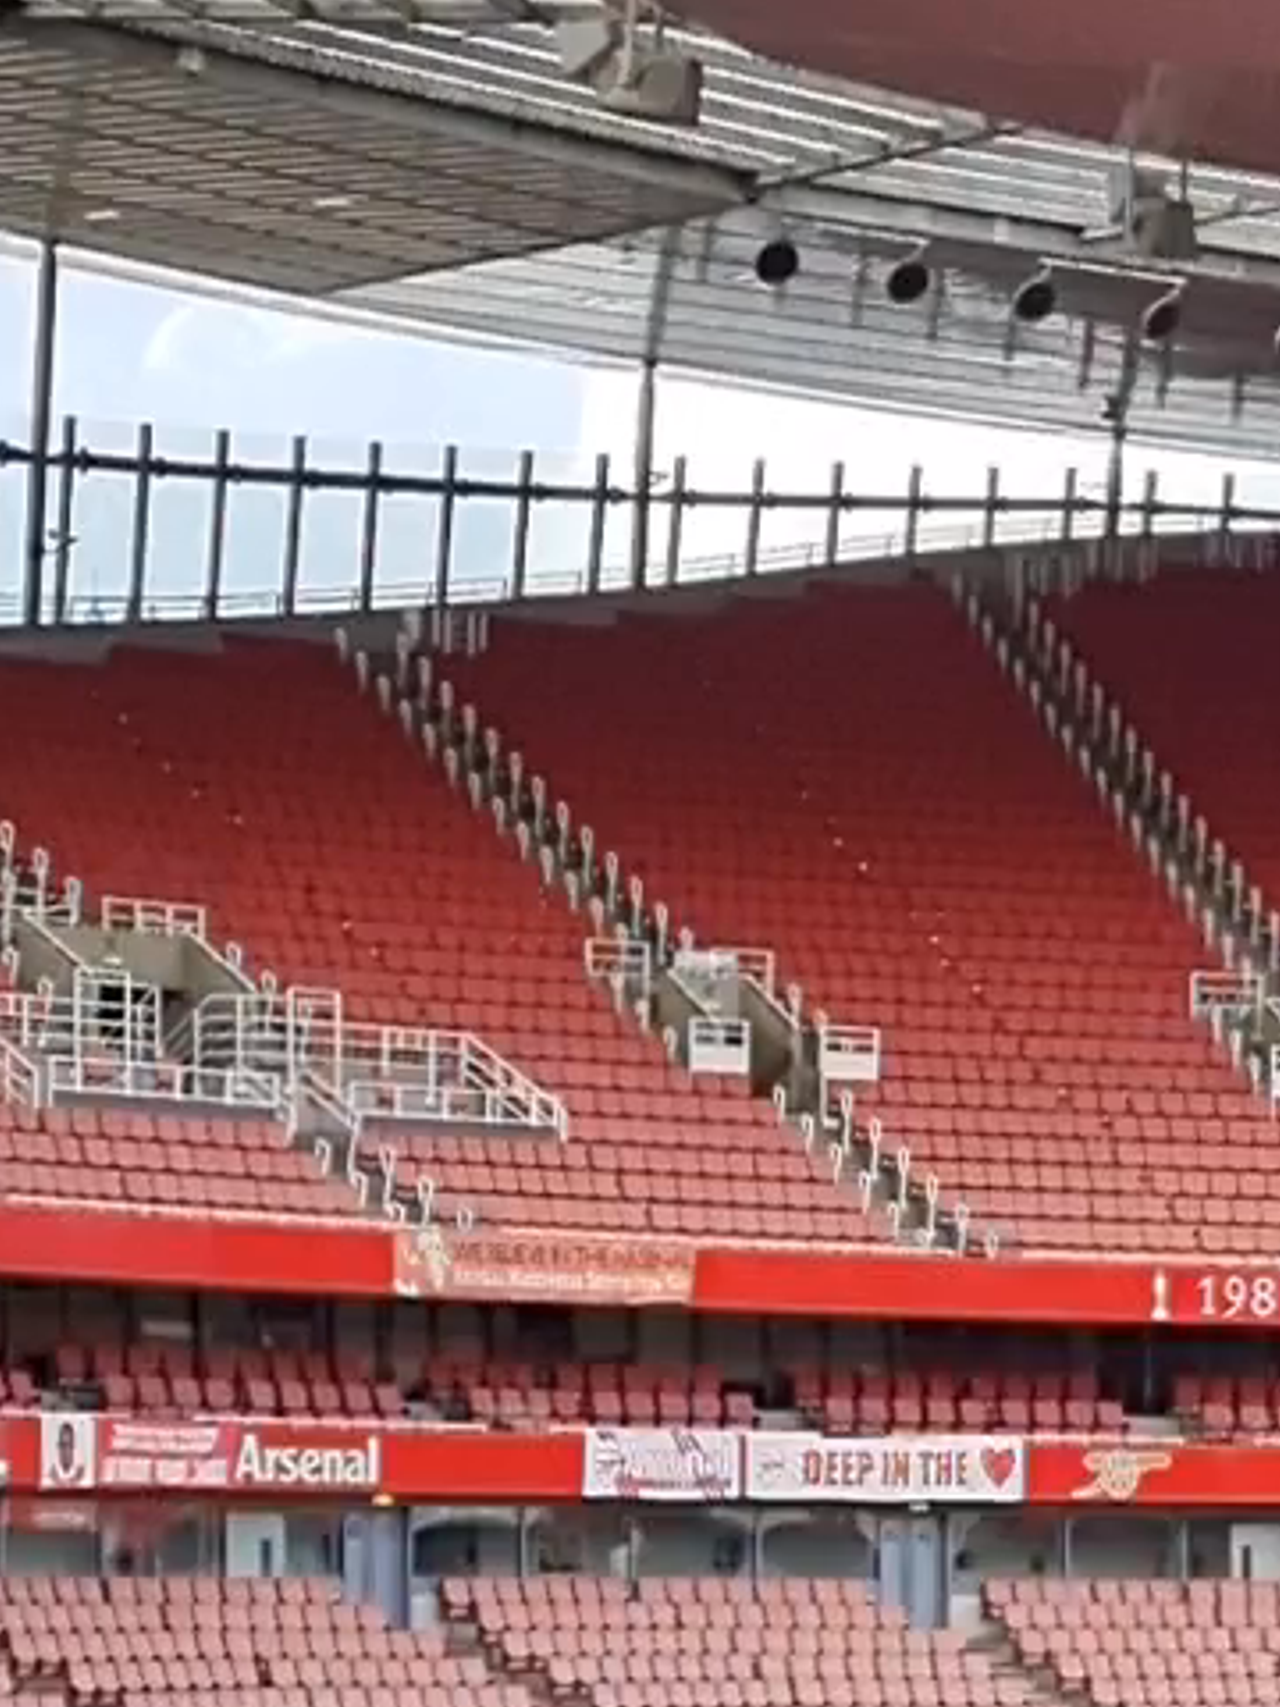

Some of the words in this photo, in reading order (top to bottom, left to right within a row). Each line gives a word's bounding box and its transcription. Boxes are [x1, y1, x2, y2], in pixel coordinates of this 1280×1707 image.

[236, 1433, 379, 1483] Arsenal
[803, 1449, 873, 1486] DEEP
[881, 1451, 910, 1486] IN
[917, 1451, 968, 1486] THE
